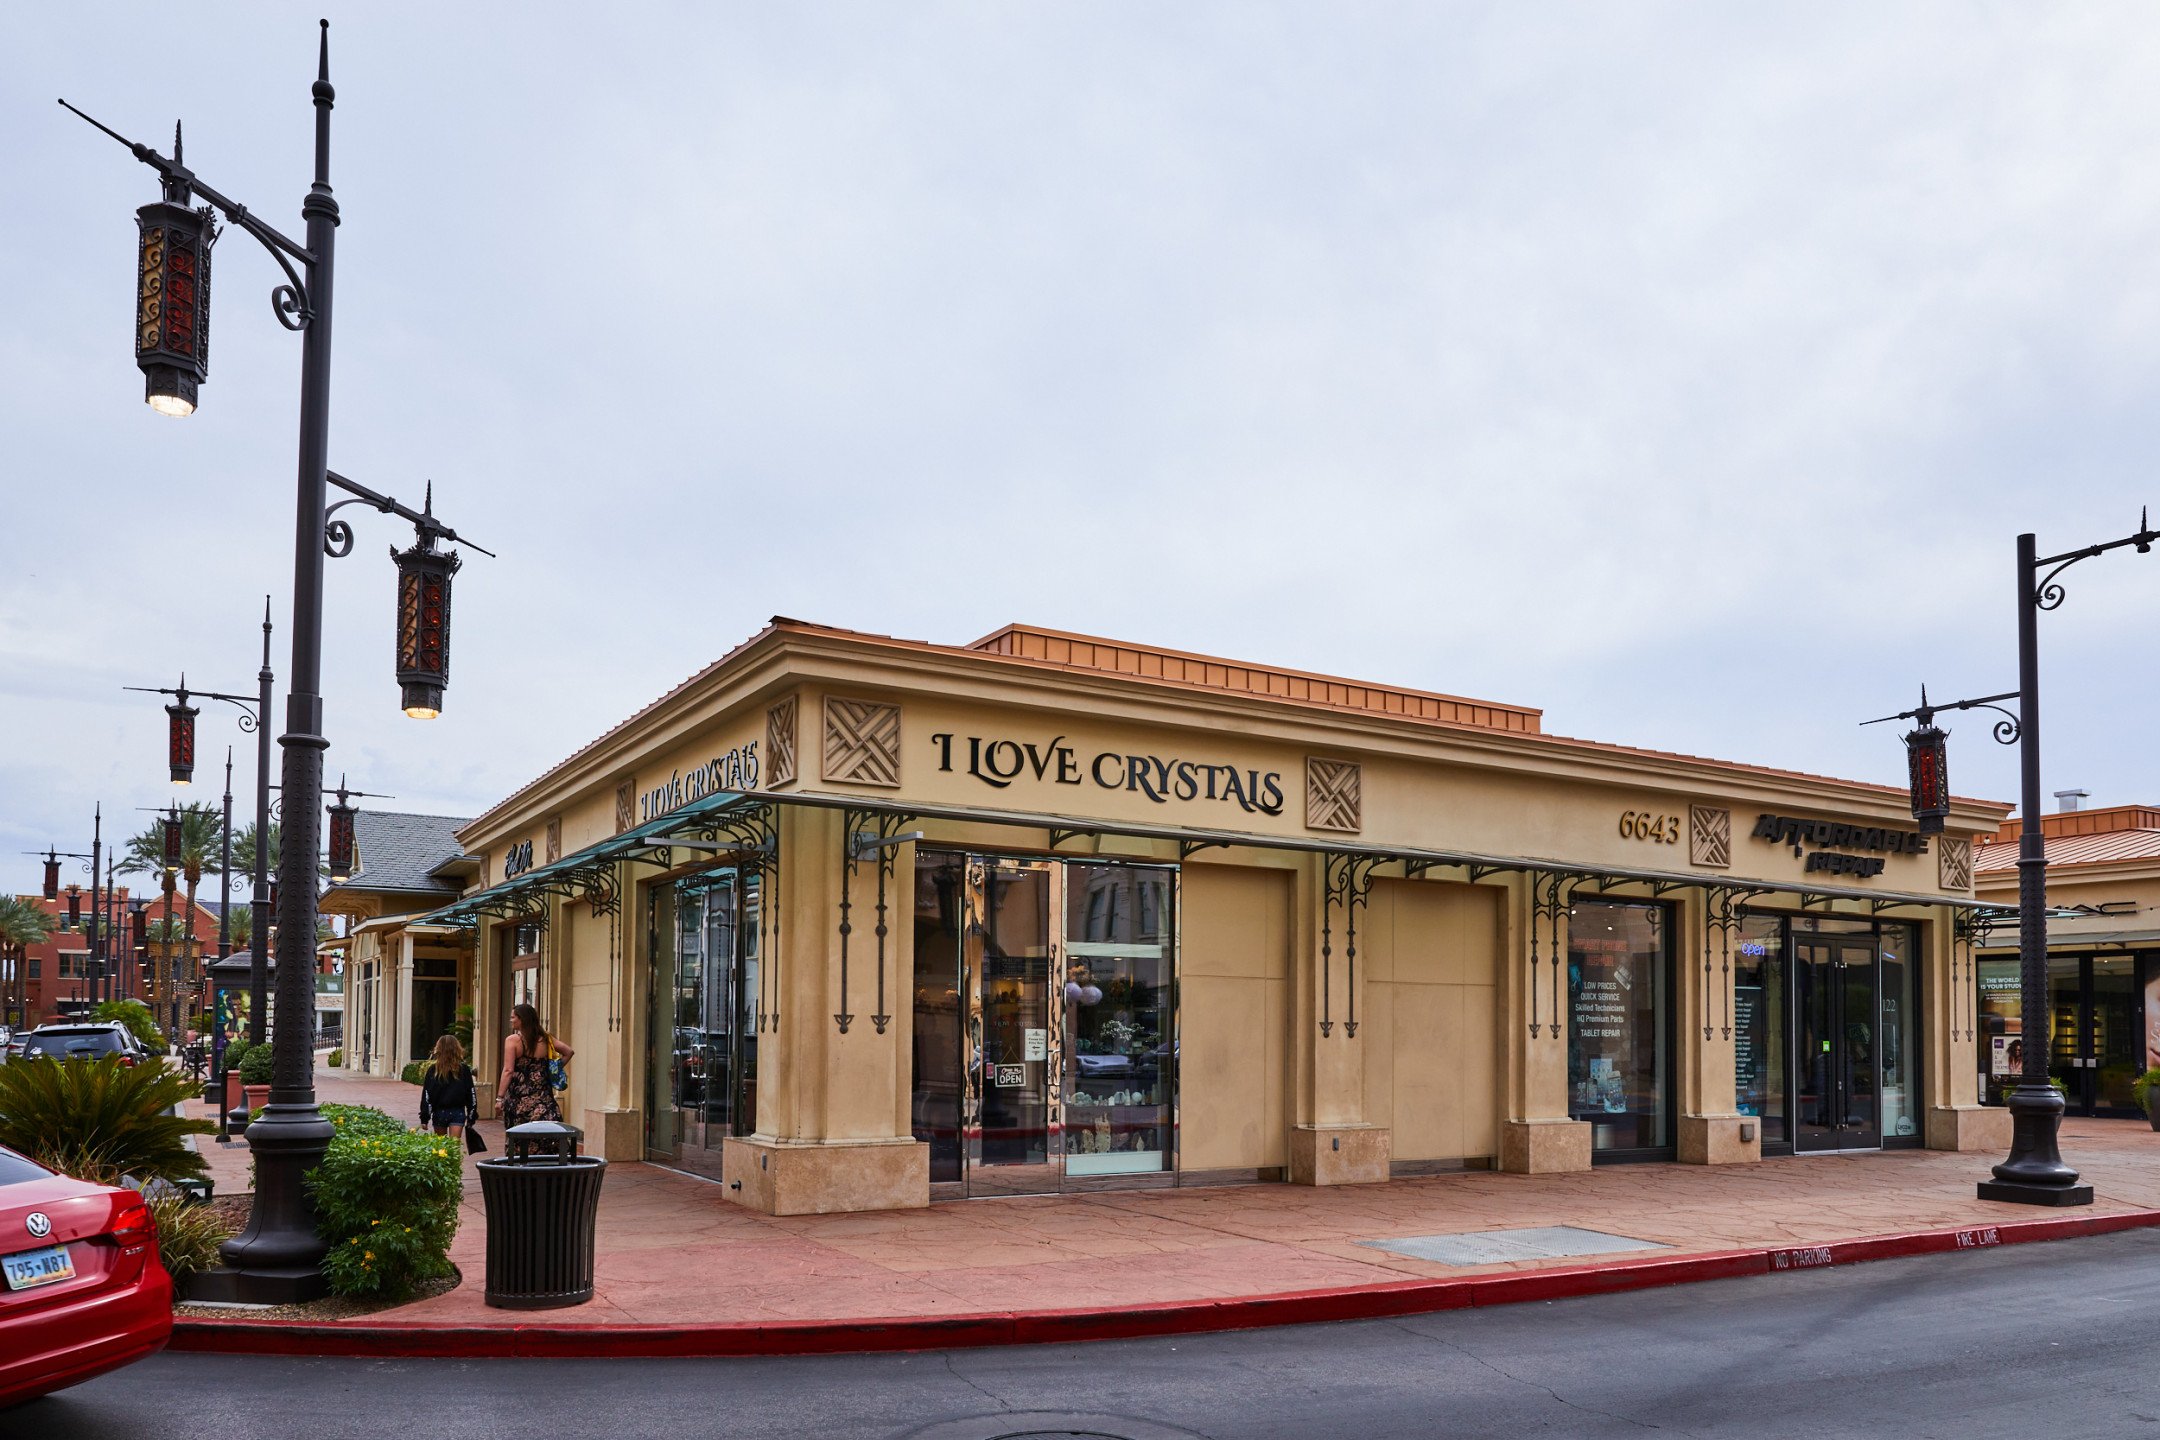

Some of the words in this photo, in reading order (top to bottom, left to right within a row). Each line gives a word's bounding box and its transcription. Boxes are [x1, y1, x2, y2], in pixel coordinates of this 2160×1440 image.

[684, 740, 759, 803] CRYSTALS
[931, 733, 954, 772] I
[967, 736, 1083, 788] LOVE
[1091, 752, 1284, 816] CRYSTALS
[1619, 810, 1681, 844] 6643
[1752, 814, 1932, 856] AFFORDABLE
[1804, 851, 1886, 879] REPAIR
[1584, 981, 1597, 990] LOW
[1597, 981, 1617, 990] PRICES
[1580, 993, 1597, 1001] QUICK
[1598, 993, 1620, 1001] SERVICE
[1575, 1003, 1593, 1012] Skilled
[1594, 1004, 1625, 1012] Technicians
[1882, 999, 1896, 1012] 122
[1576, 1015, 1585, 1023] HQ
[1586, 1015, 1609, 1023] Premium
[1610, 1015, 1624, 1023] Parts
[1581, 1029, 1600, 1037] TABLET
[1601, 1029, 1621, 1037] REPAIR
[999, 1074, 1022, 1084] OPEN
[1956, 1231, 1975, 1247] FIRE
[1977, 1229, 2000, 1245] LANE
[1775, 1252, 1788, 1269] NO
[1794, 1247, 1832, 1265] PARKING
